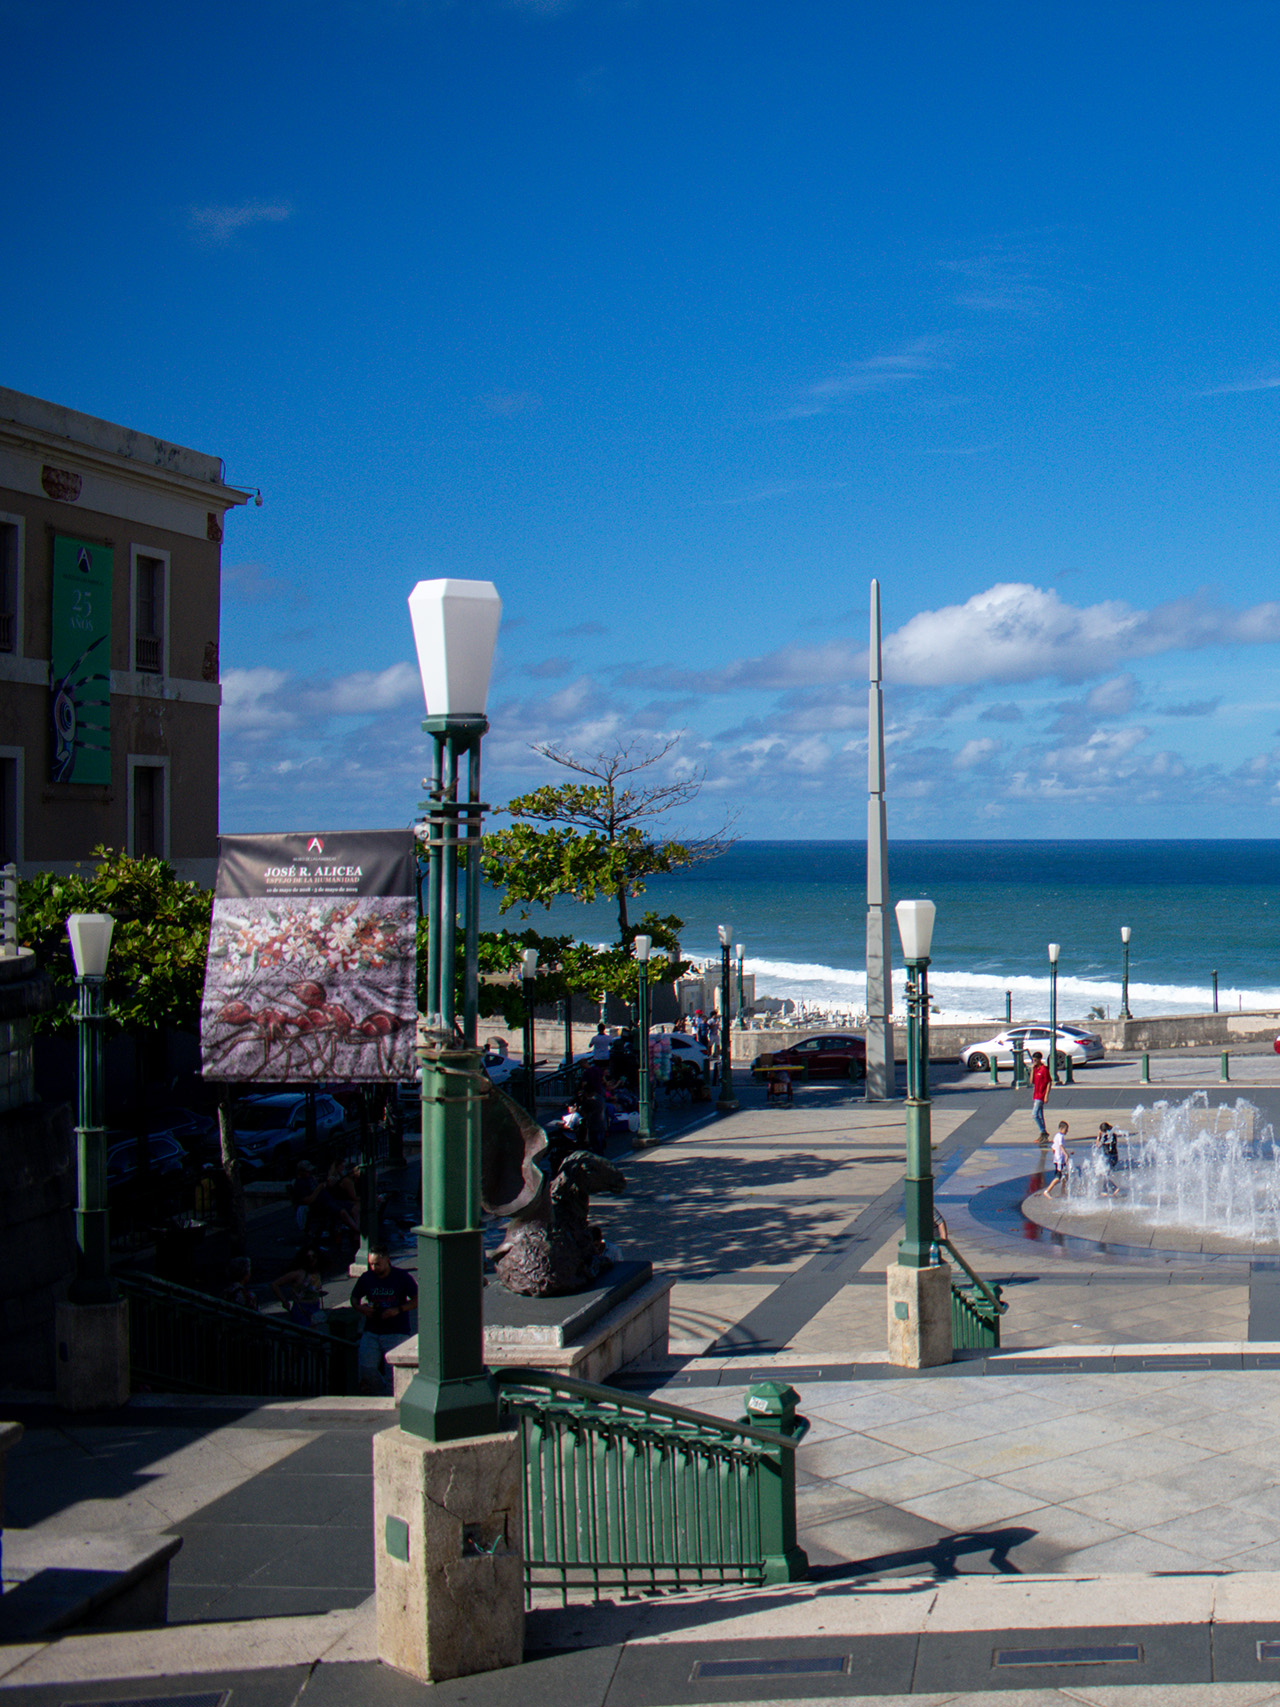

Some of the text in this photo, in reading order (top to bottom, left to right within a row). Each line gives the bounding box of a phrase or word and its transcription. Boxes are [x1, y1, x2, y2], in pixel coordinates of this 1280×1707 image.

[72, 590, 92, 618] 25
[264, 865, 363, 877] JOSÉ R. ALICEA
